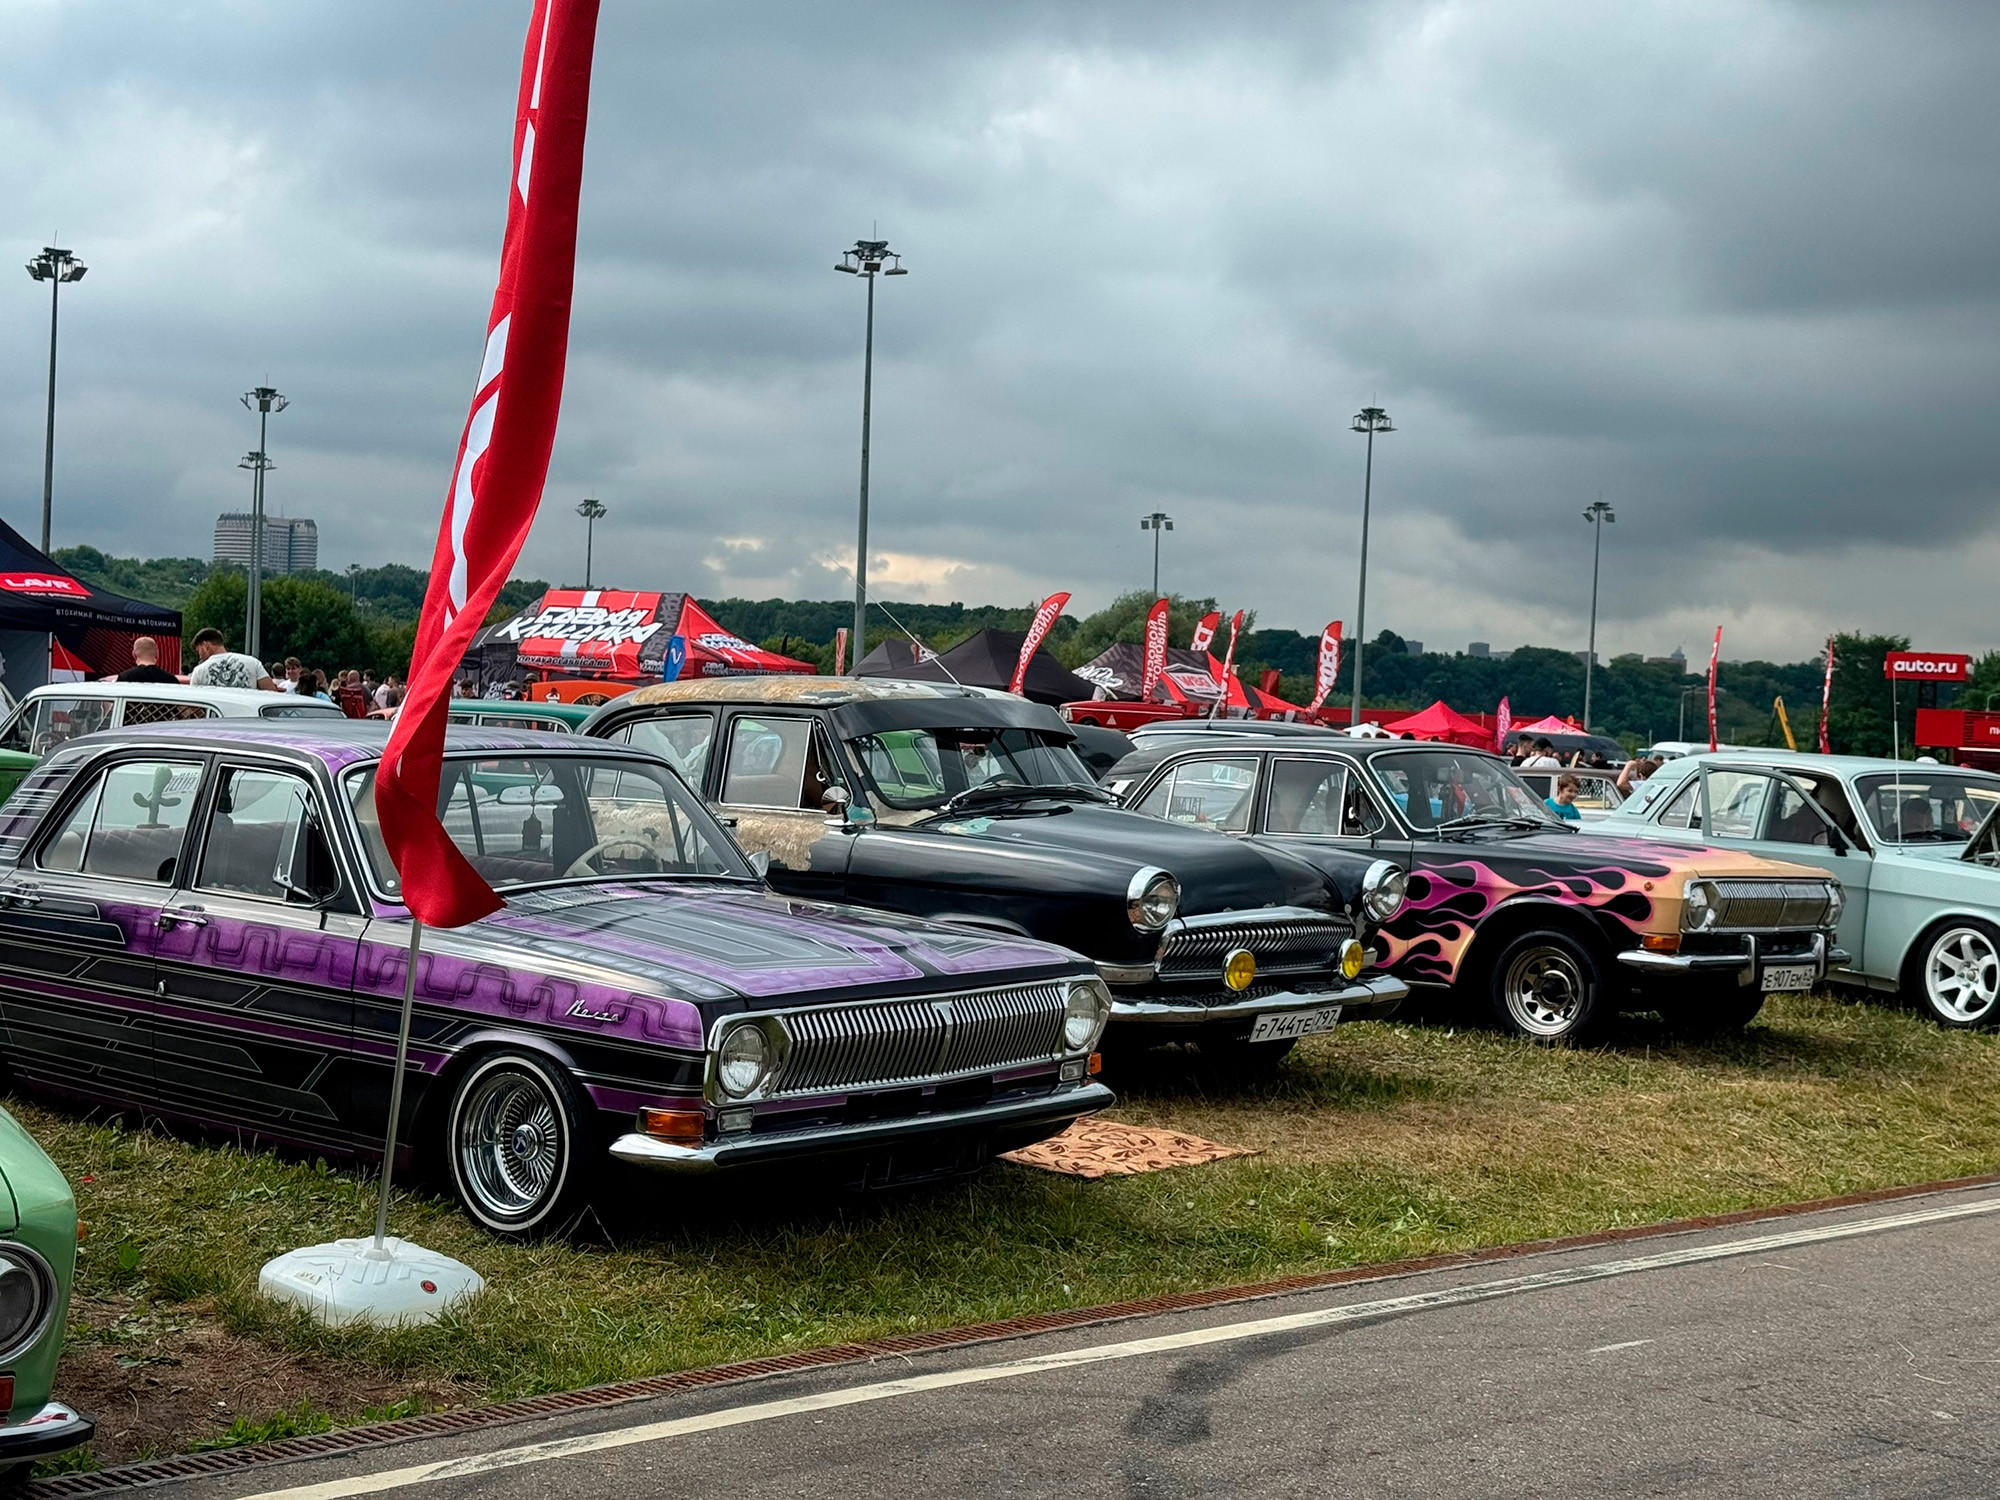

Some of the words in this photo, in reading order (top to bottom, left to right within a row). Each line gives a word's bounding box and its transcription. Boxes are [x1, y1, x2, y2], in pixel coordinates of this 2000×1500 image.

[5, 578, 73, 590] LAVR
[1893, 660, 1957, 674] auto.ru
[1315, 1009, 1338, 1026] 797
